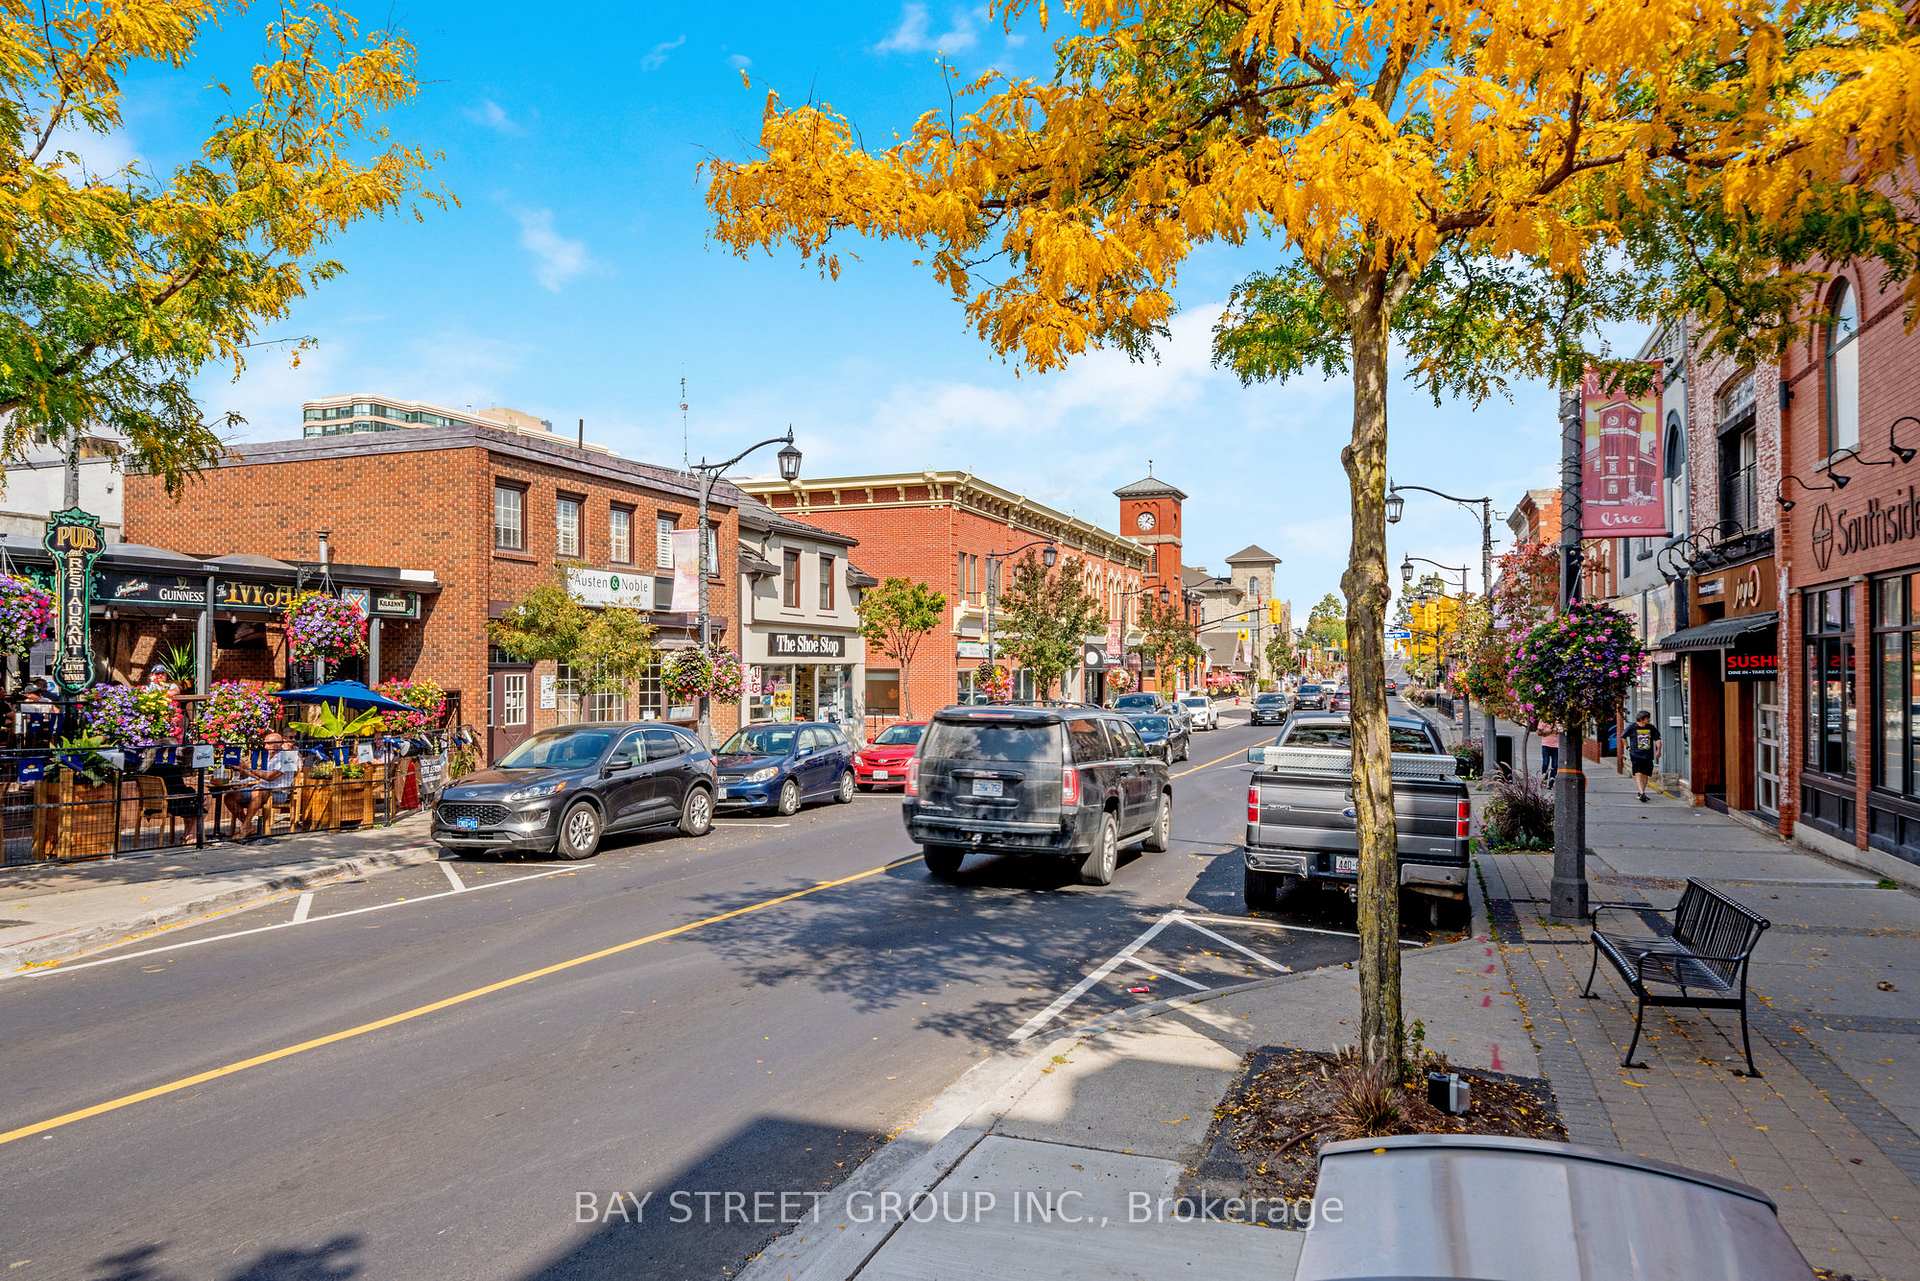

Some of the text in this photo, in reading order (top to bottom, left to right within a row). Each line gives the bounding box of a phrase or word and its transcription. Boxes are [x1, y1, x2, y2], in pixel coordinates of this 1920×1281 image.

[57, 526, 97, 549] PUB
[224, 580, 264, 604] IVY
[574, 573, 648, 592] Austen & Noble
[159, 588, 206, 602] GUINNESS
[380, 599, 405, 608] KILKENNY
[67, 557, 84, 655] RESTAURANT
[776, 634, 839, 656] The Shoe Stop
[1727, 655, 1777, 667] SUSHI
